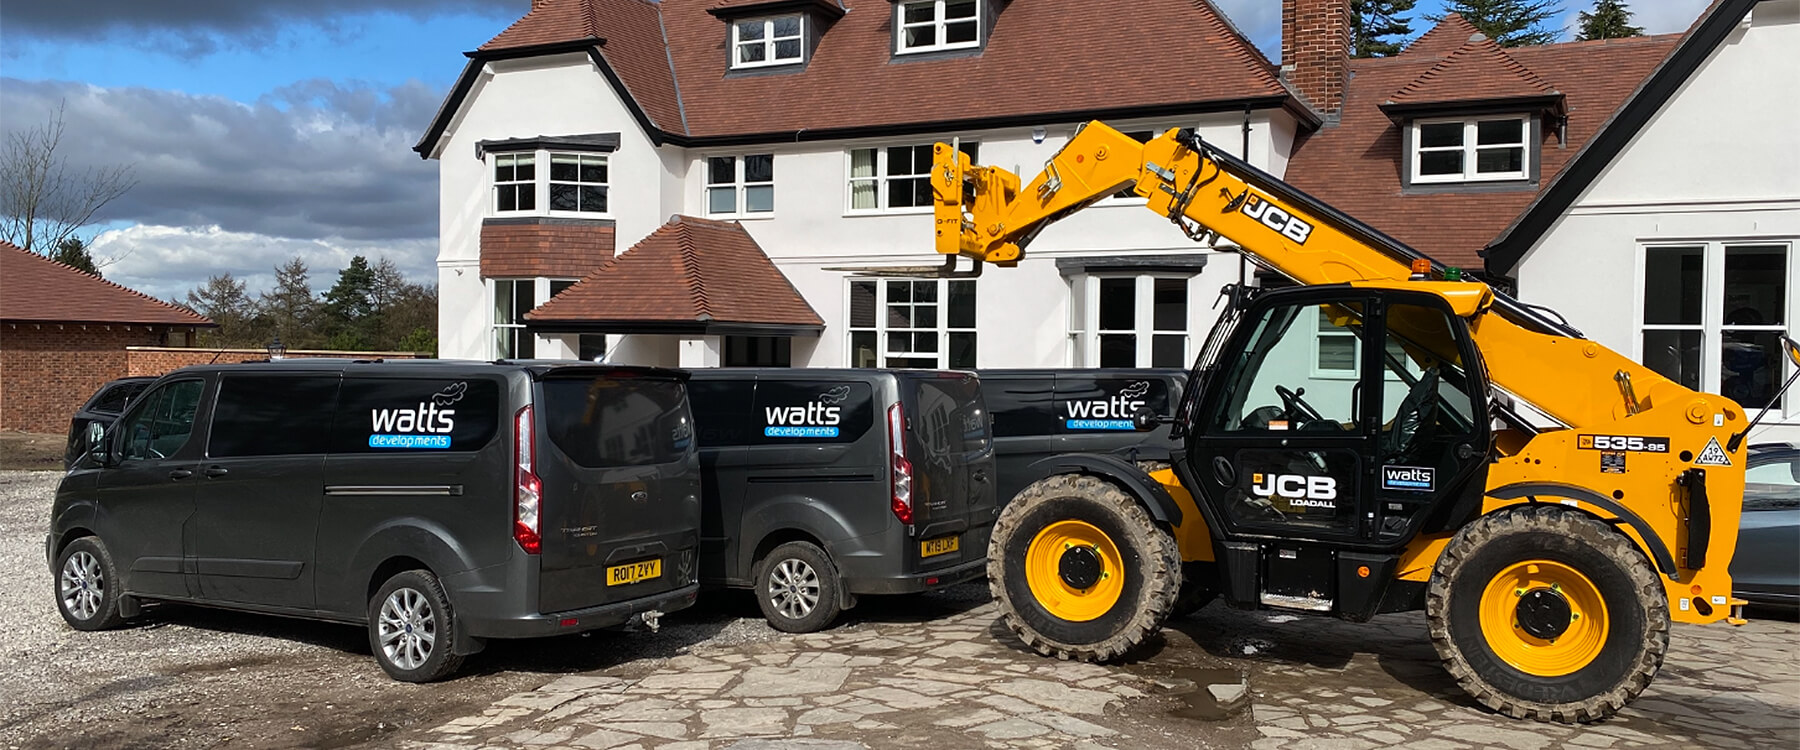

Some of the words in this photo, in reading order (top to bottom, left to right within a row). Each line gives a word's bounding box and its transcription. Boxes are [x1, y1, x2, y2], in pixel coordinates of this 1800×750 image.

[1243, 195, 1312, 244] JCB
[372, 402, 455, 433] watts
[765, 401, 841, 425] watts
[1073, 420, 1135, 429] development
[767, 427, 836, 438] developments
[372, 434, 448, 448] developments
[1594, 436, 1666, 452] 535-95
[1708, 447, 1719, 455] 19
[1386, 469, 1431, 482] watts
[1252, 473, 1337, 500] JCB
[1289, 499, 1336, 508] LOADALL
[613, 566, 636, 582] RO17
[638, 562, 656, 578] ZVY
